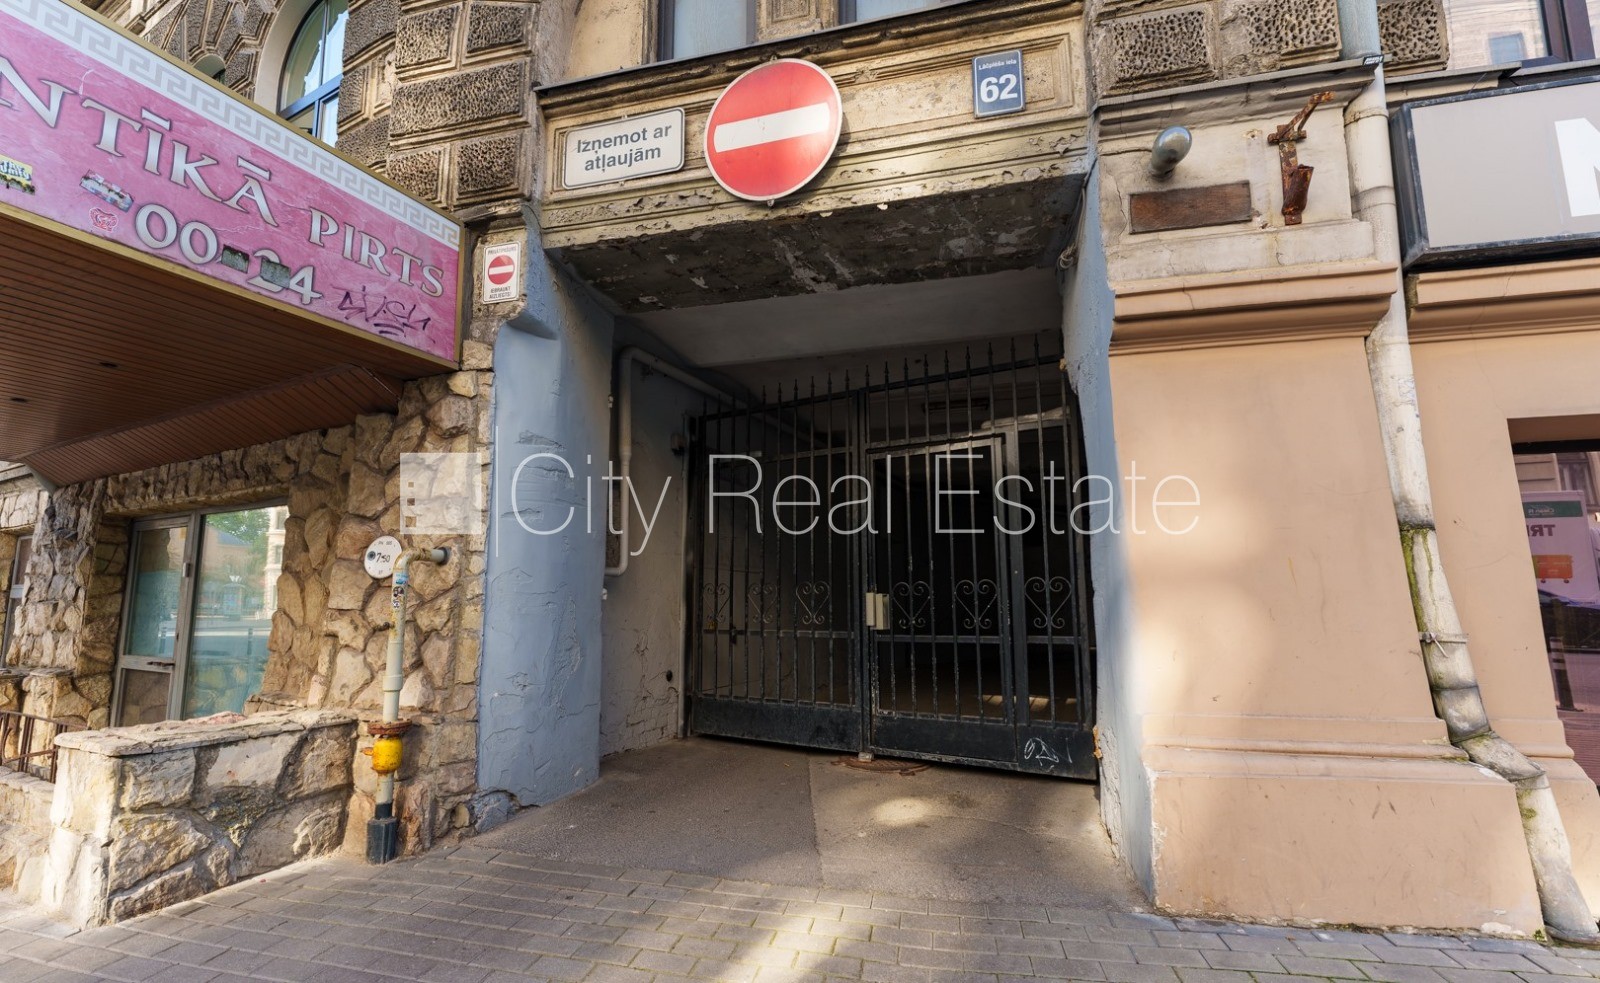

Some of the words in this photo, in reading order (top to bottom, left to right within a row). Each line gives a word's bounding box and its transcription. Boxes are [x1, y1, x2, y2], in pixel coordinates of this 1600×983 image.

[980, 73, 1018, 103] 62
[577, 128, 648, 154] Izņemot
[653, 125, 672, 139] ar
[584, 147, 662, 173] atļaujām
[308, 206, 444, 298] PIRTS
